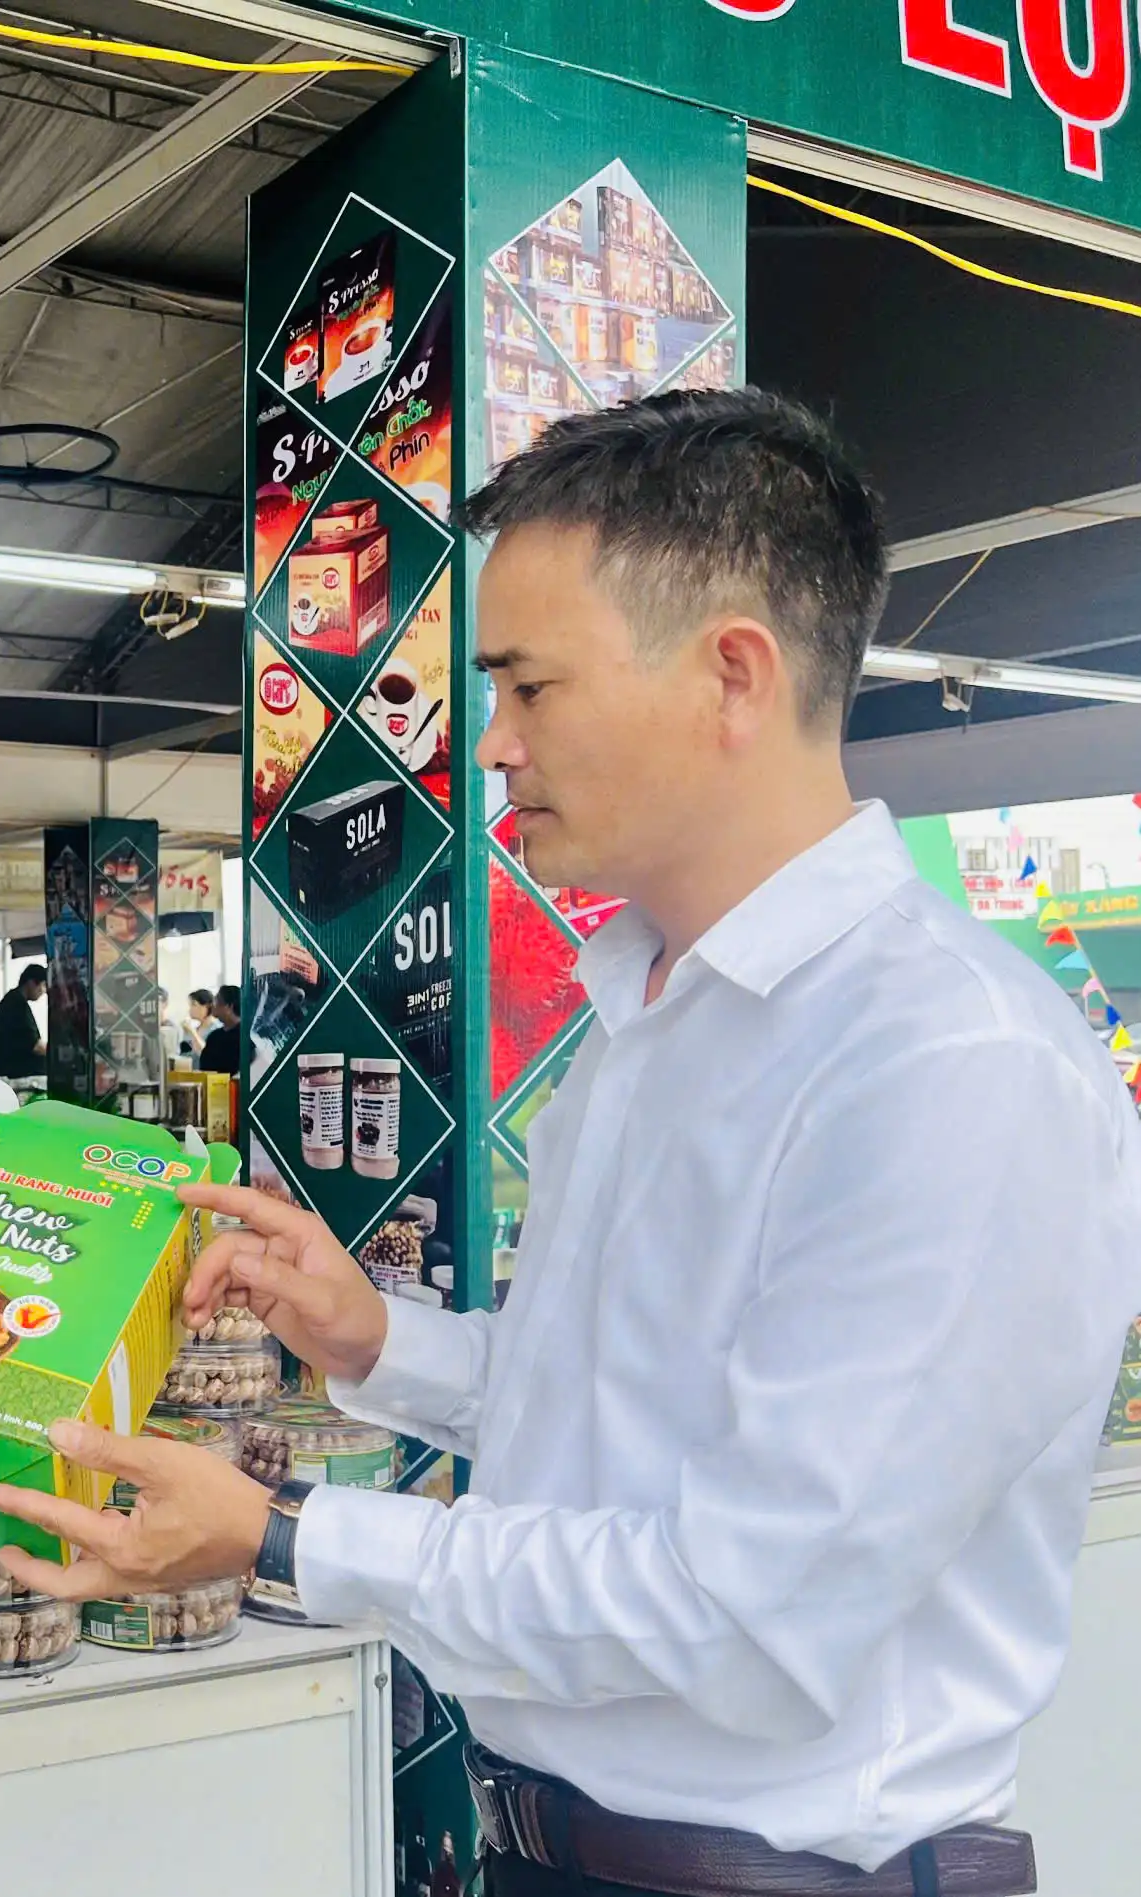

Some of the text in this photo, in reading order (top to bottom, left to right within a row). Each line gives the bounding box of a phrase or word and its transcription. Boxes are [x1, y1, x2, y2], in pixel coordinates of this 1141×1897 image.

[388, 430, 431, 471] Phin
[346, 803, 386, 850] SOLA
[406, 988, 430, 1008] 3IN1
[82, 1143, 192, 1183] OCOP
[14, 1174, 61, 1195] RANG
